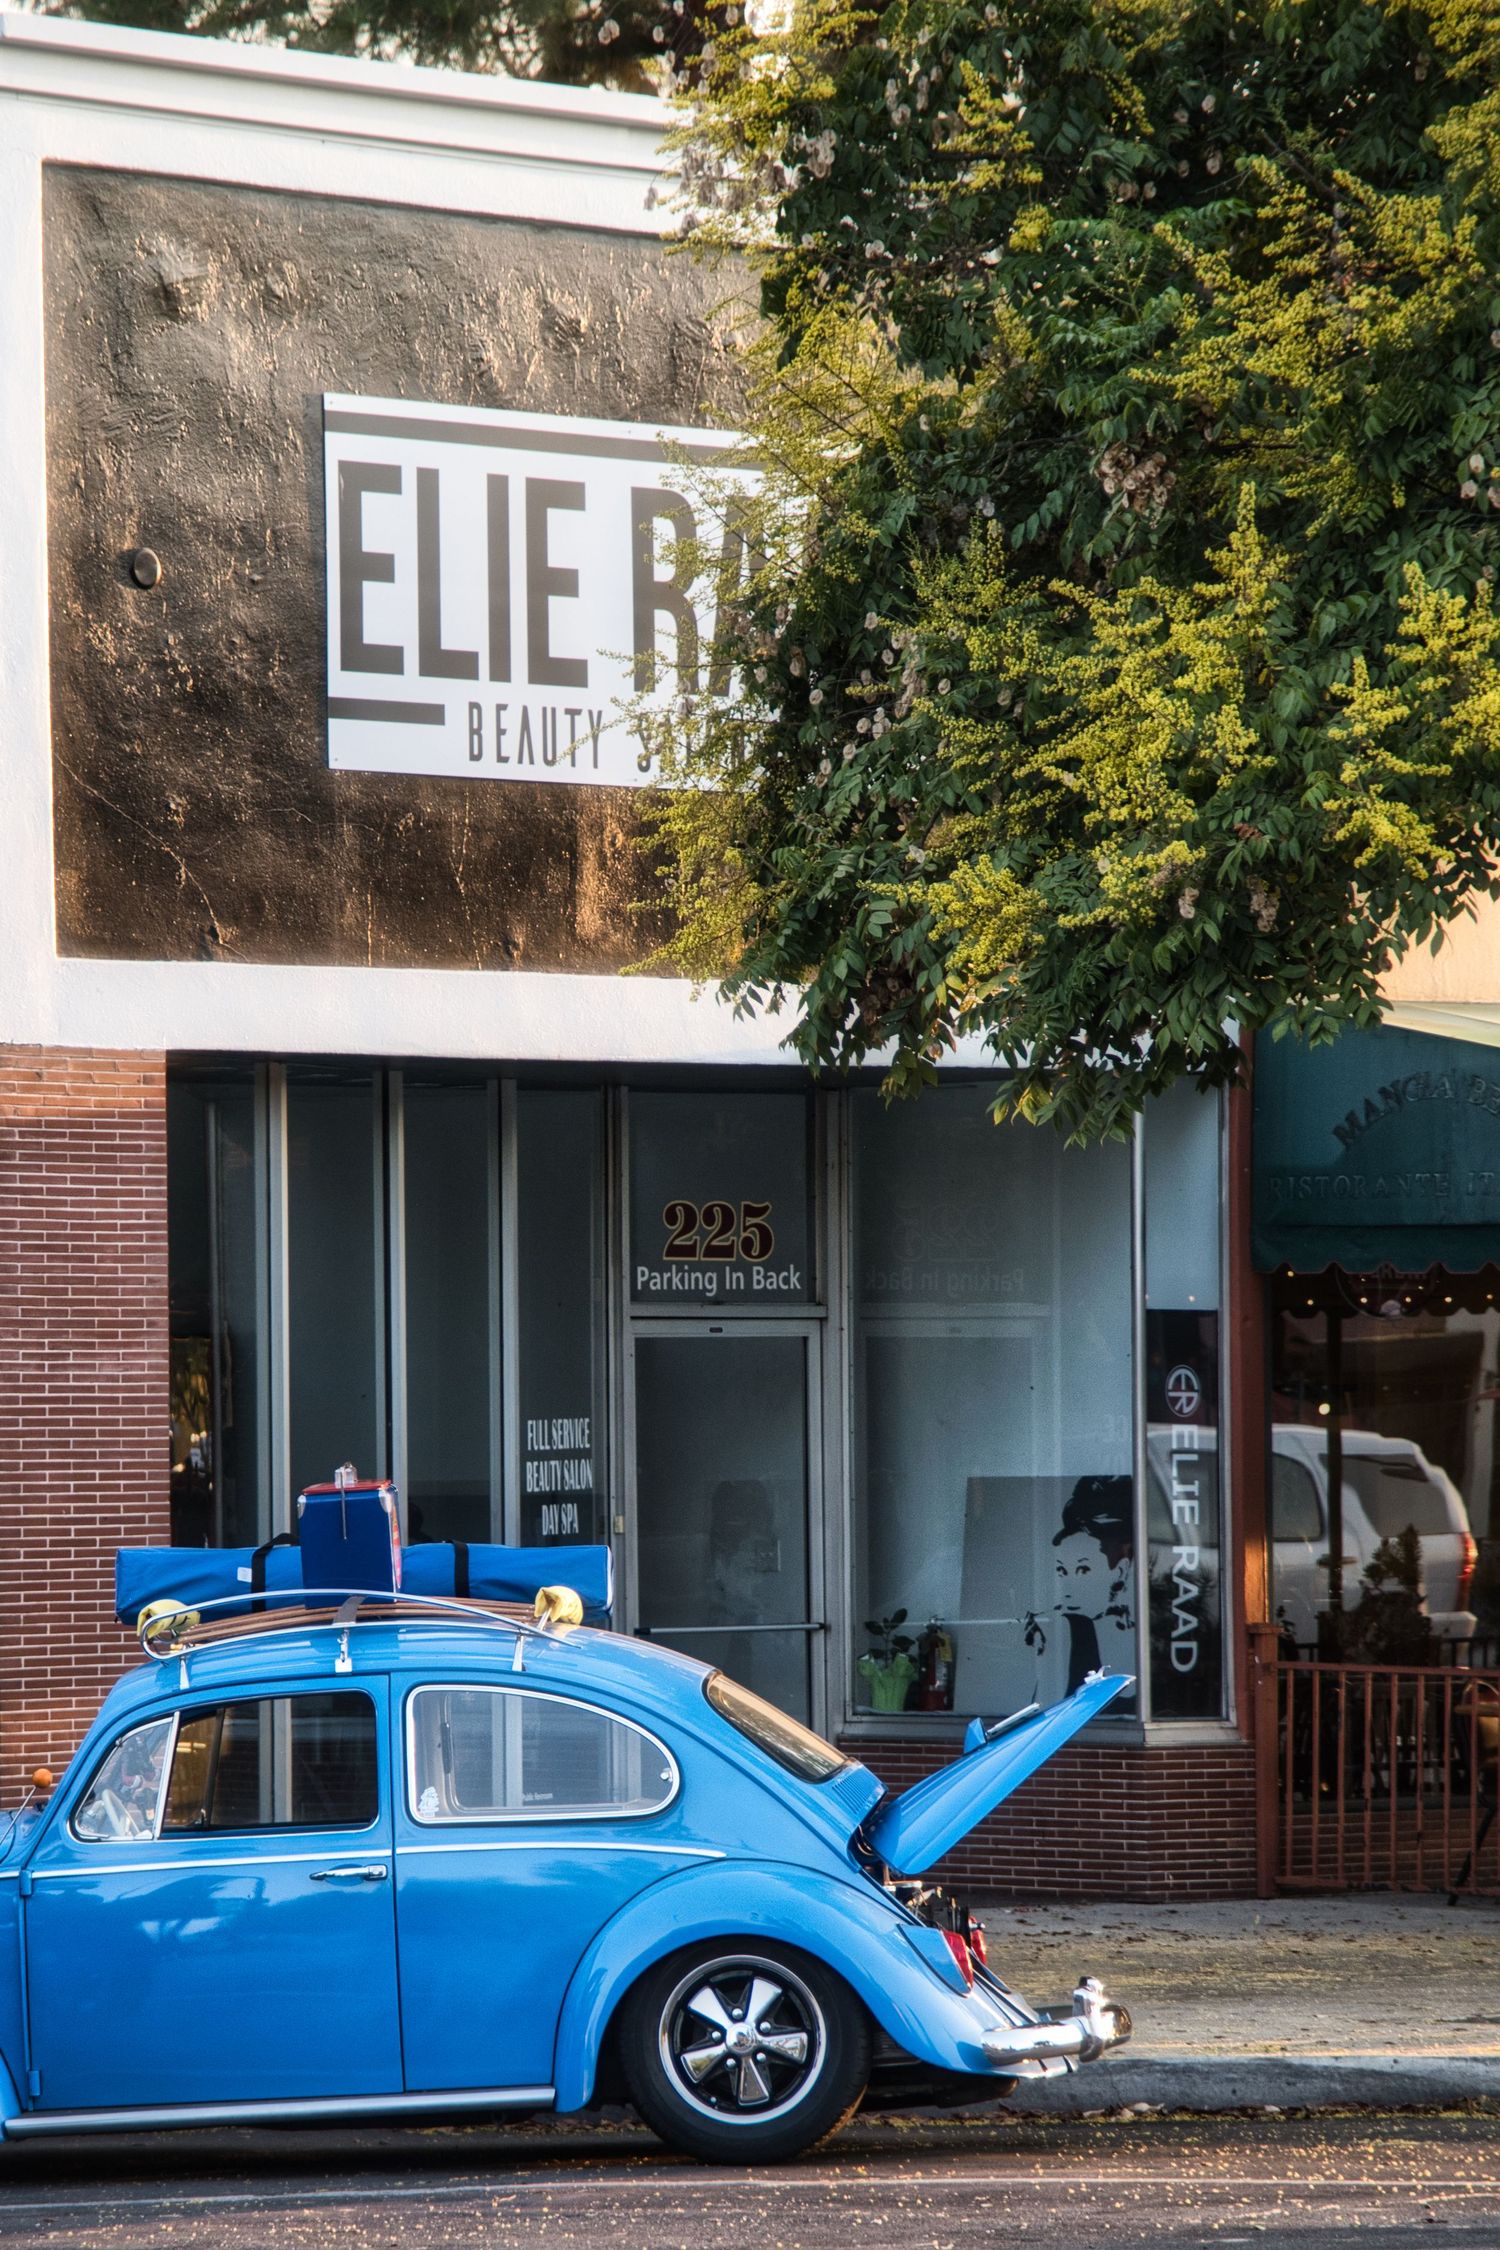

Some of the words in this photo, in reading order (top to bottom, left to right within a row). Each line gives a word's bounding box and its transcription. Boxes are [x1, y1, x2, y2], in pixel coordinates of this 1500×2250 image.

[338, 460, 588, 689] ELIE
[468, 701, 603, 770] BEAUTY
[1268, 1173, 1451, 1200] RISTORANTE
[662, 1200, 775, 1262] 225
[637, 1264, 717, 1297] Parking
[725, 1266, 745, 1290] In
[753, 1264, 801, 1290] Back
[527, 1419, 551, 1450] FULL
[552, 1418, 590, 1450] SERVICE
[526, 1460, 563, 1492] BEAUTY
[563, 1458, 593, 1490] SALON
[1171, 1424, 1199, 1525] ELIE
[542, 1504, 560, 1535] DAY
[561, 1503, 579, 1534] SPA
[1170, 1545, 1199, 1673] RAAD
